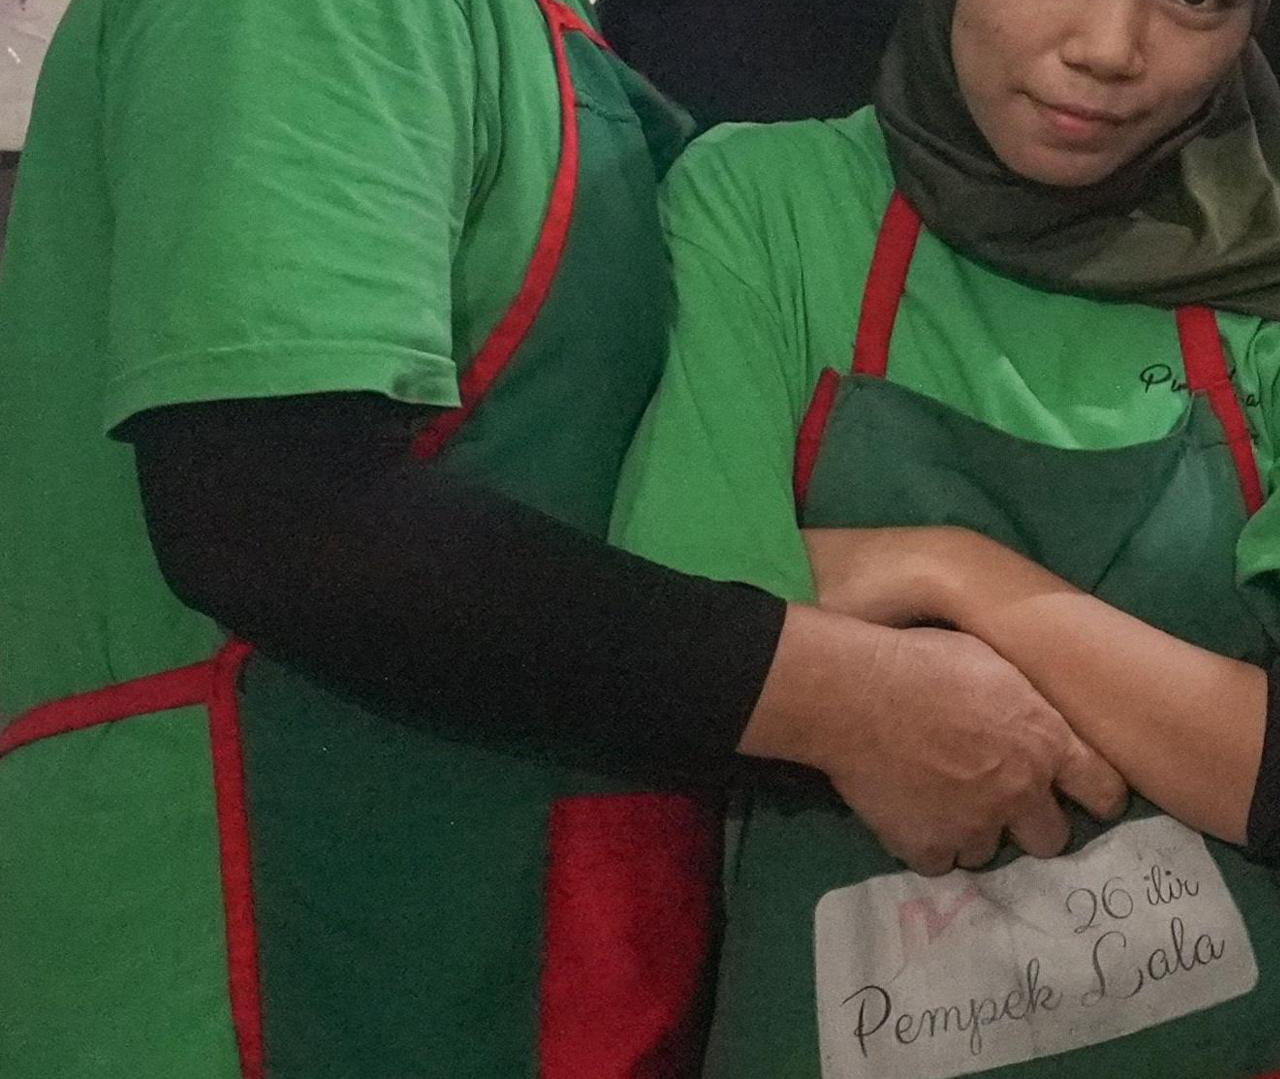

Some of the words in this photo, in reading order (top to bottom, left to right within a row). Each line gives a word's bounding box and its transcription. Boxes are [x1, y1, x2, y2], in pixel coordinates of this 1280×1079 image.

[1066, 875, 1135, 935] 26
[1145, 864, 1201, 906] ilir
[842, 957, 1063, 1059] Pempek
[1081, 916, 1226, 1008] Lala
